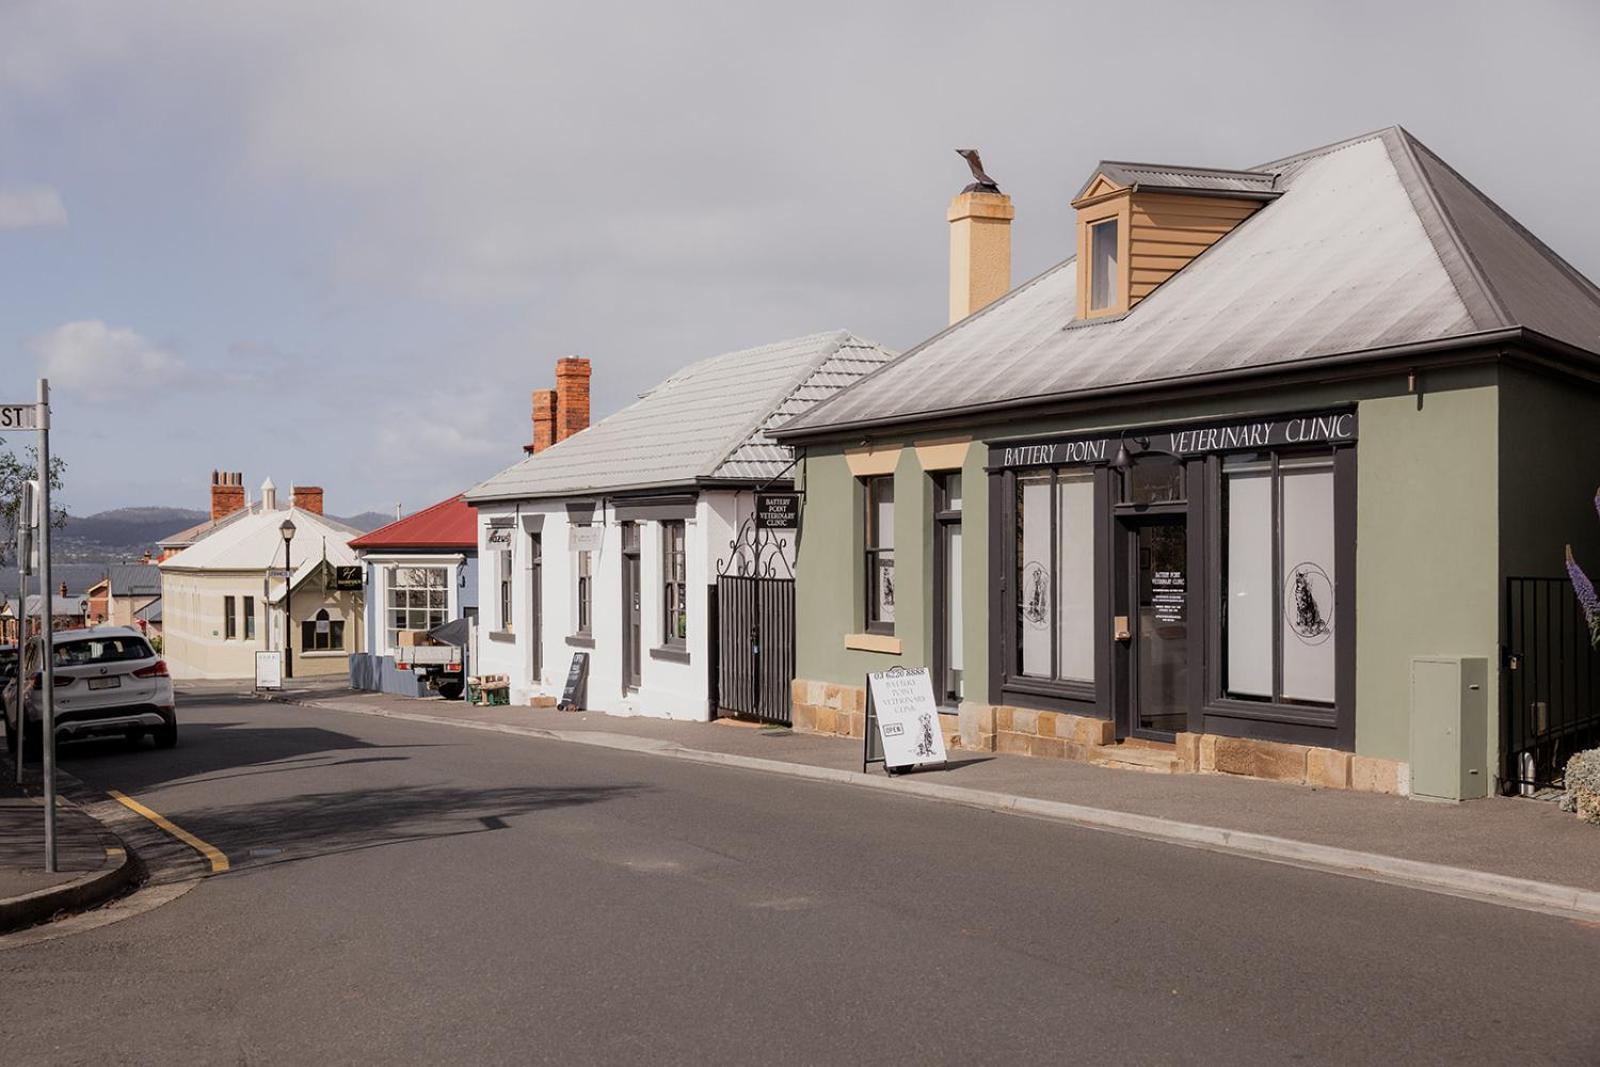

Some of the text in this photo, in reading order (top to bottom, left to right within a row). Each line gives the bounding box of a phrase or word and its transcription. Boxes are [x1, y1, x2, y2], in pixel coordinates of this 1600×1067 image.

[1, 407, 23, 427] ST
[1003, 413, 1354, 467] BATTERY POINT VETERINARY CLINIC
[885, 726, 901, 734] OPEN
